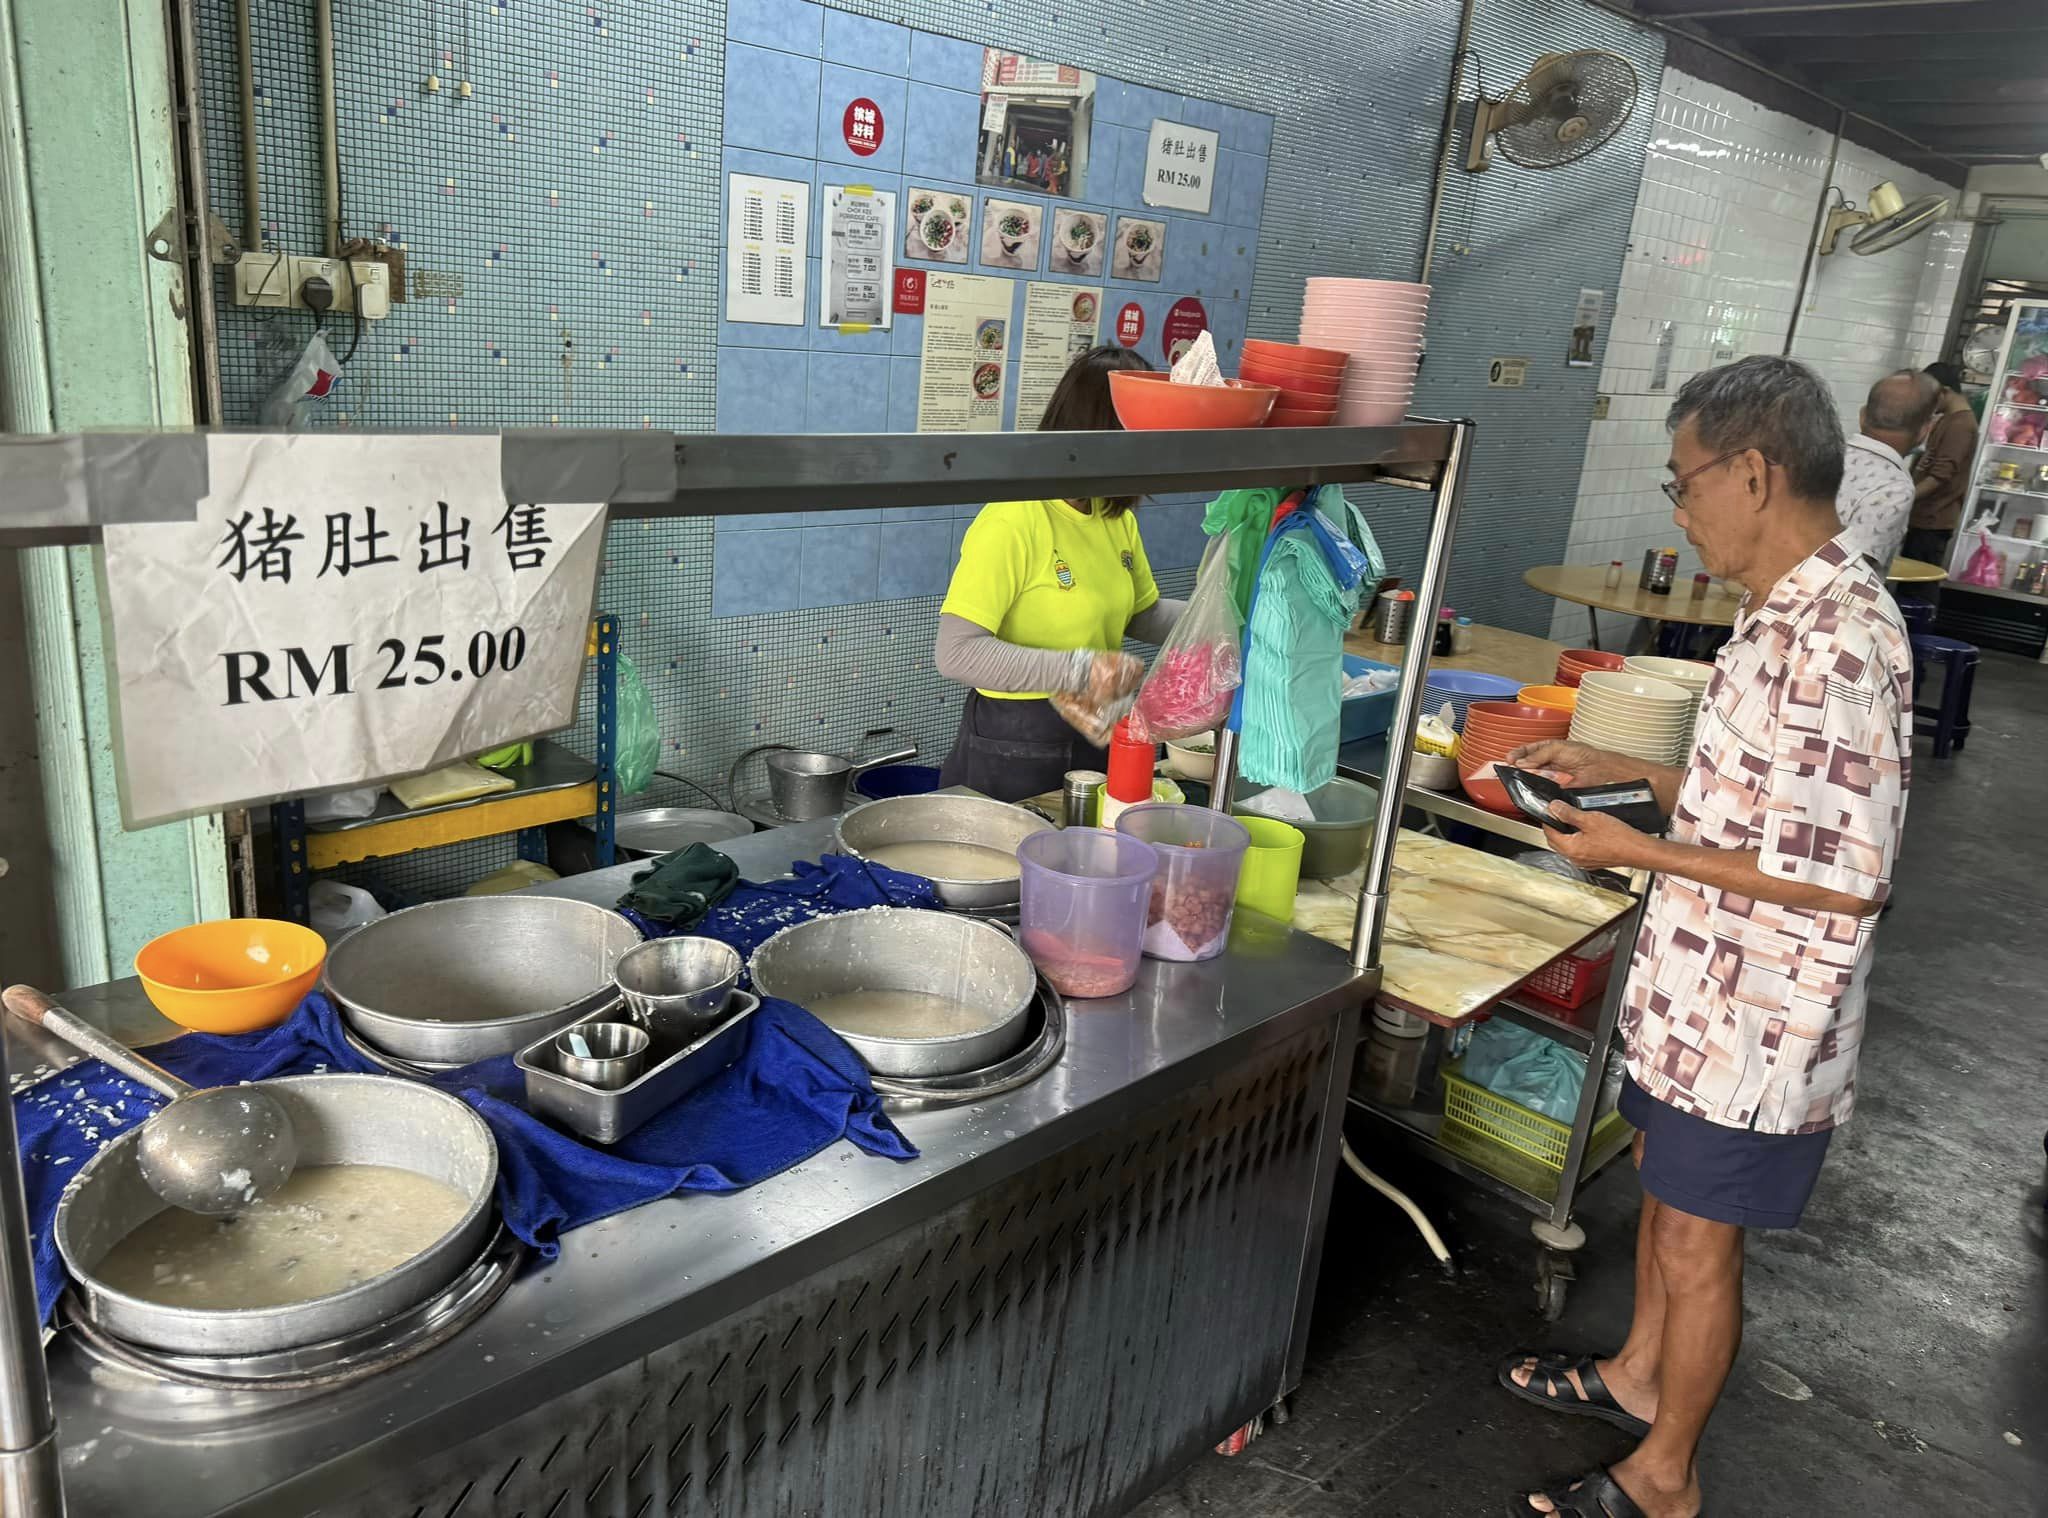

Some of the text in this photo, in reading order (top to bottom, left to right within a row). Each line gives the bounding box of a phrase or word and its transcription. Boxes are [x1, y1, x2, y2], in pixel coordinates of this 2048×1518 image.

[1161, 137, 1208, 163] 猪肚出售
[1157, 168, 1201, 189] RM 25.00
[217, 501, 553, 586] 猪肚出售
[217, 626, 527, 707] RM 25.00
